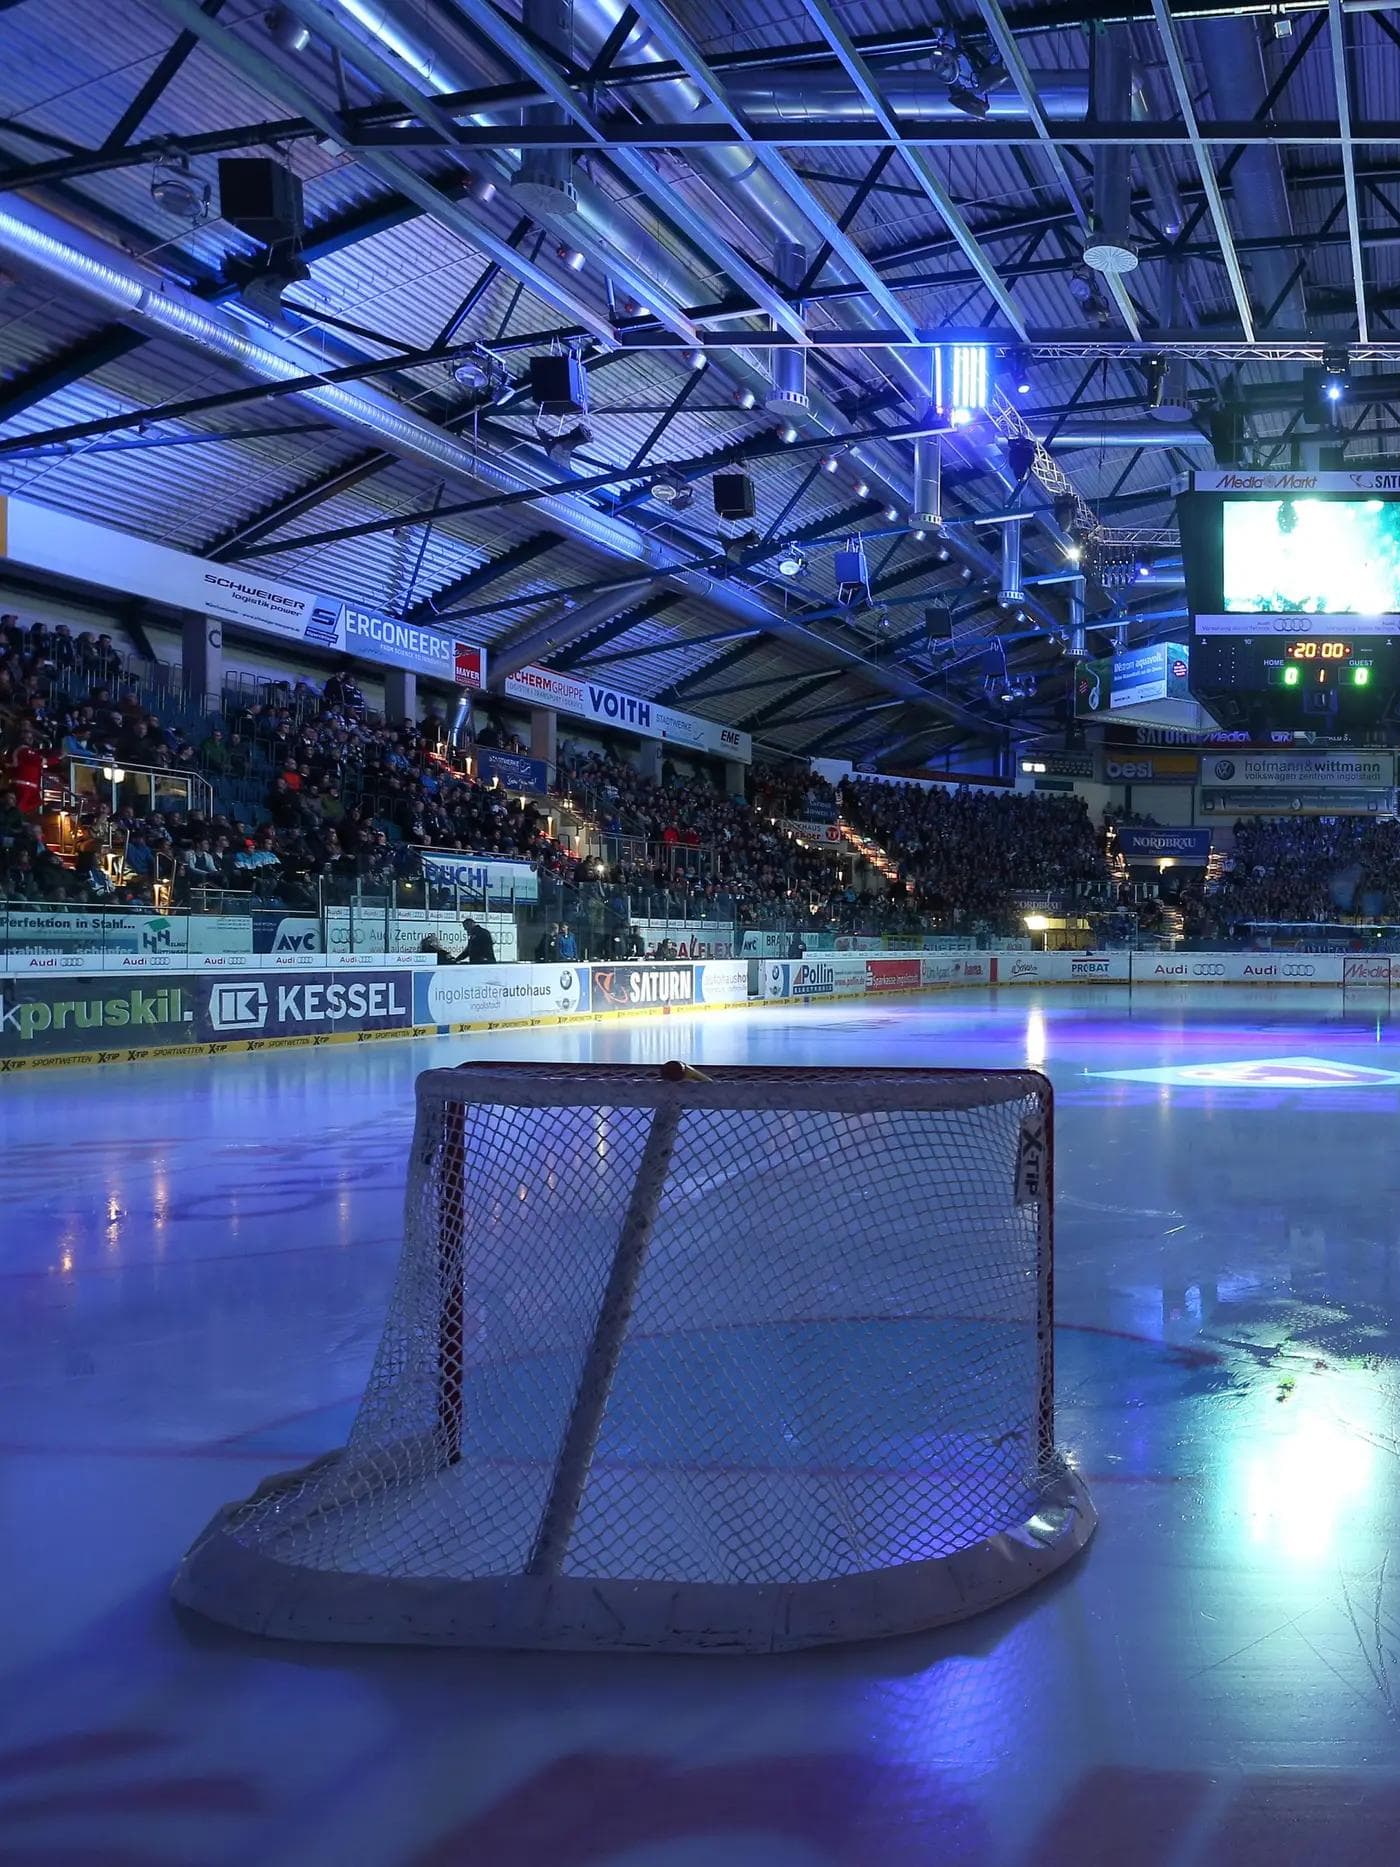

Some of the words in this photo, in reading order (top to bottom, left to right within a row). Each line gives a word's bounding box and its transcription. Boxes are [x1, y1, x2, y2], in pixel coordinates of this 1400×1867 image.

[1215, 474, 1263, 488] Media
[1274, 474, 1318, 488] Markt
[204, 574, 305, 610] SCHWEIGER
[232, 592, 270, 609] logistik
[270, 604, 302, 617] power
[345, 610, 450, 661] ERGONEERS
[1293, 642, 1345, 658] 20:00
[456, 666, 480, 681] MAYER
[1284, 667, 1298, 685] 0
[1354, 667, 1369, 685] 0
[588, 686, 650, 728] VOITH
[656, 713, 692, 733] STADTWERKE
[721, 729, 740, 745] EME
[1245, 760, 1380, 772] hofmann&wittmann
[1133, 836, 1197, 849] NORDBRÄU
[1, 917, 70, 929] Perfektion
[76, 917, 88, 929] in
[92, 917, 136, 930] Stahl...
[277, 932, 316, 951] AVC
[30, 958, 57, 967] Audi
[123, 957, 147, 966] Audi
[204, 957, 226, 965] Audi
[276, 956, 296, 964] Audi
[801, 963, 834, 985] Pollin
[1155, 964, 1188, 975] Audi
[1243, 964, 1277, 975] Audi
[1346, 964, 1390, 979] Media
[629, 970, 692, 1003] SATURN
[278, 983, 406, 1022] KESSEL
[127, 1049, 149, 1061] X-TIP
[153, 1046, 204, 1057] SPORTWETTEN
[208, 1044, 228, 1055] X-TIP
[1, 1059, 26, 1072] X-TIP
[32, 1055, 92, 1068] SPORTWETTEN
[98, 1052, 120, 1064] X-TIP
